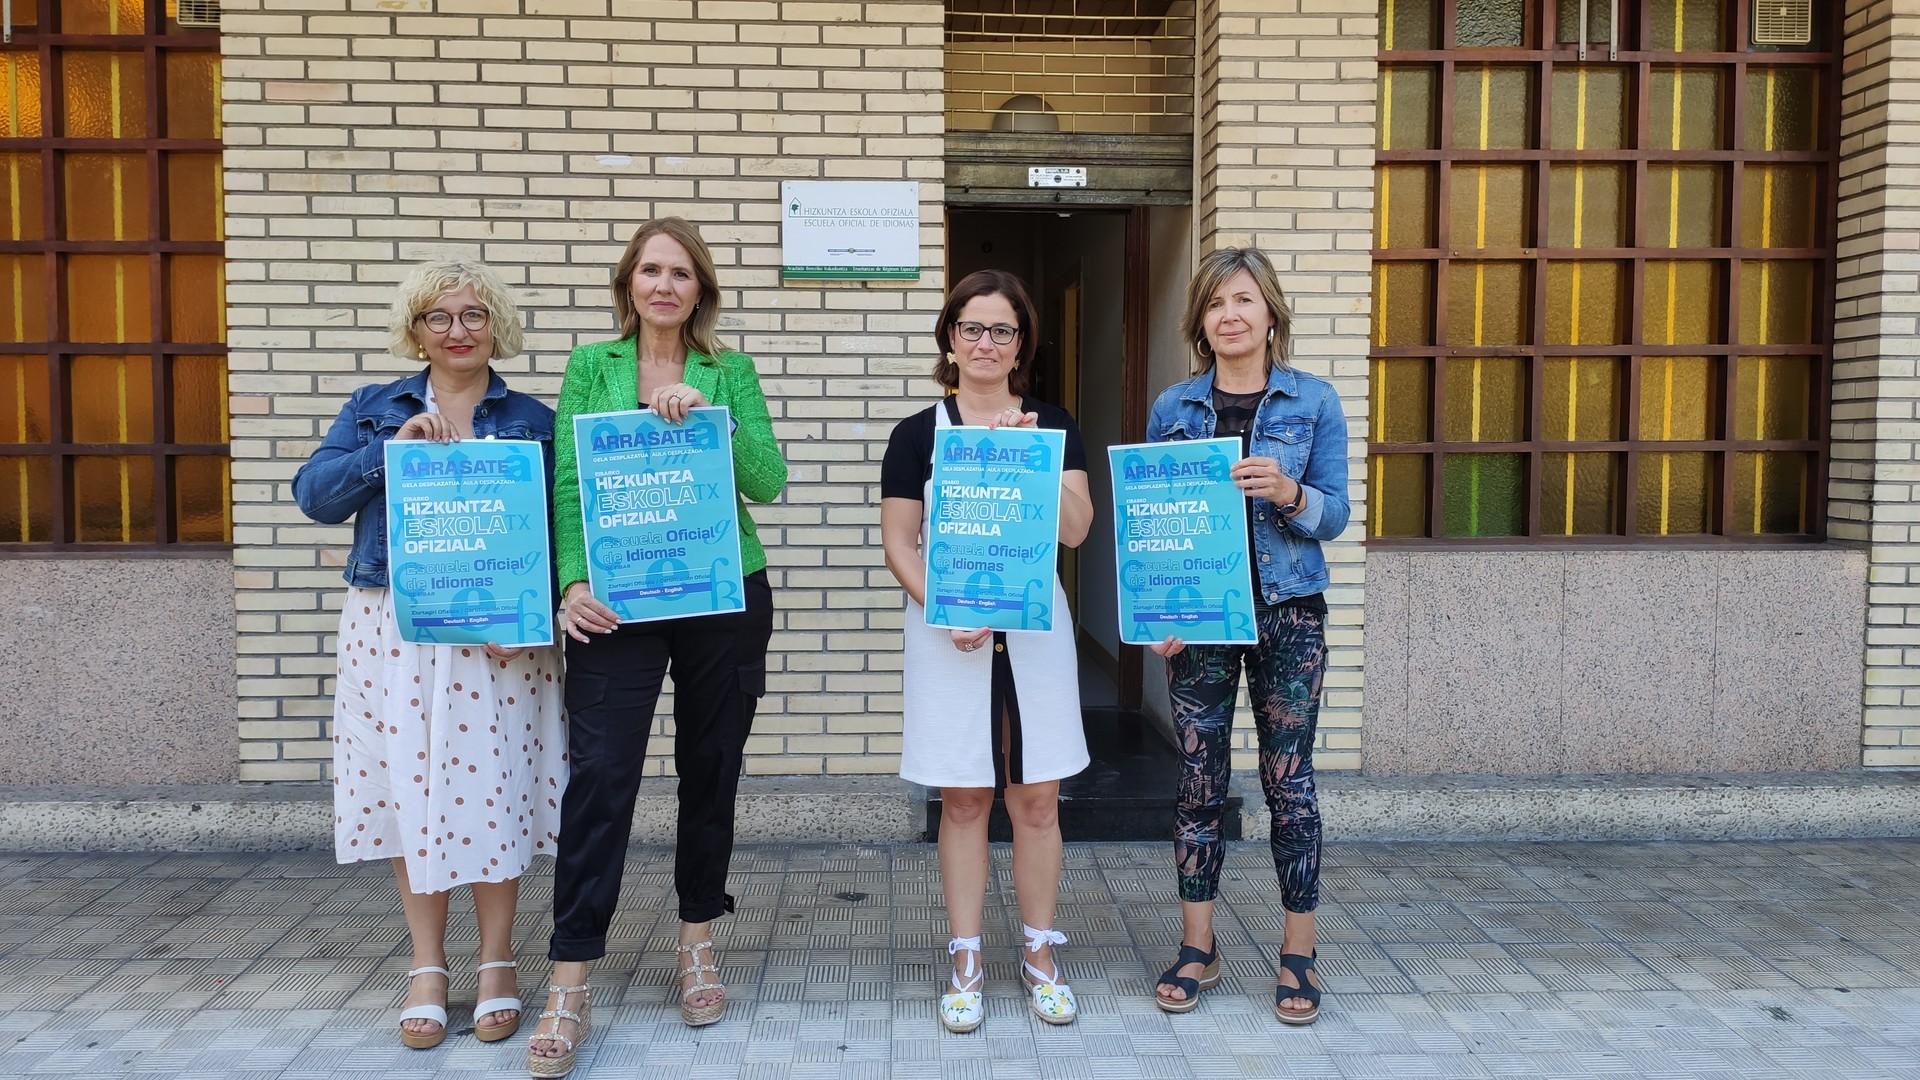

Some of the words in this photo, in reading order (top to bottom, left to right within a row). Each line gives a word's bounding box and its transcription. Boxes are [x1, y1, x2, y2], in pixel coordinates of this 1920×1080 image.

[850, 208, 877, 216] ESKOLA
[881, 208, 913, 216] OFIZIALA
[804, 219, 835, 227] ESCUELA
[883, 220, 914, 228] IDIOMAS
[592, 428, 696, 451] ARRASATE
[944, 447, 1032, 462] ARRASATE
[402, 460, 509, 476] ARRASATE
[1124, 461, 1211, 479] ARRASATE
[595, 470, 694, 490] HIZKUNTZA
[597, 486, 697, 512] ESKOLA
[941, 486, 1022, 500] HIZKUNTZA
[404, 500, 505, 515] HIZKUNTZA
[940, 501, 1022, 522] ESKOLA
[1127, 500, 1209, 516] HIZKUNTZA
[404, 515, 507, 538] ESKOLA
[599, 509, 677, 528] OFIZIALA
[1127, 516, 1211, 537] ESKOLA
[939, 522, 1002, 536] OFIZIALA
[405, 538, 486, 554] OFIZIALA
[601, 532, 662, 549] Escuela
[666, 527, 714, 542] Oficial
[1128, 538, 1194, 552] OFIZIALA
[603, 551, 622, 564] de
[627, 547, 686, 562] Idiomas
[937, 543, 984, 556] Escuela
[988, 545, 1034, 558] Oficial
[406, 560, 469, 575] Escuela
[474, 558, 524, 571] Oficial
[936, 556, 950, 569] de
[953, 558, 1004, 572] Idiomas
[1129, 559, 1180, 572] Escuela
[1184, 558, 1227, 570] Oficial
[406, 578, 426, 590] de
[431, 576, 493, 589] Idiomas
[1130, 575, 1146, 586] de
[1150, 575, 1200, 586] Idiomas
